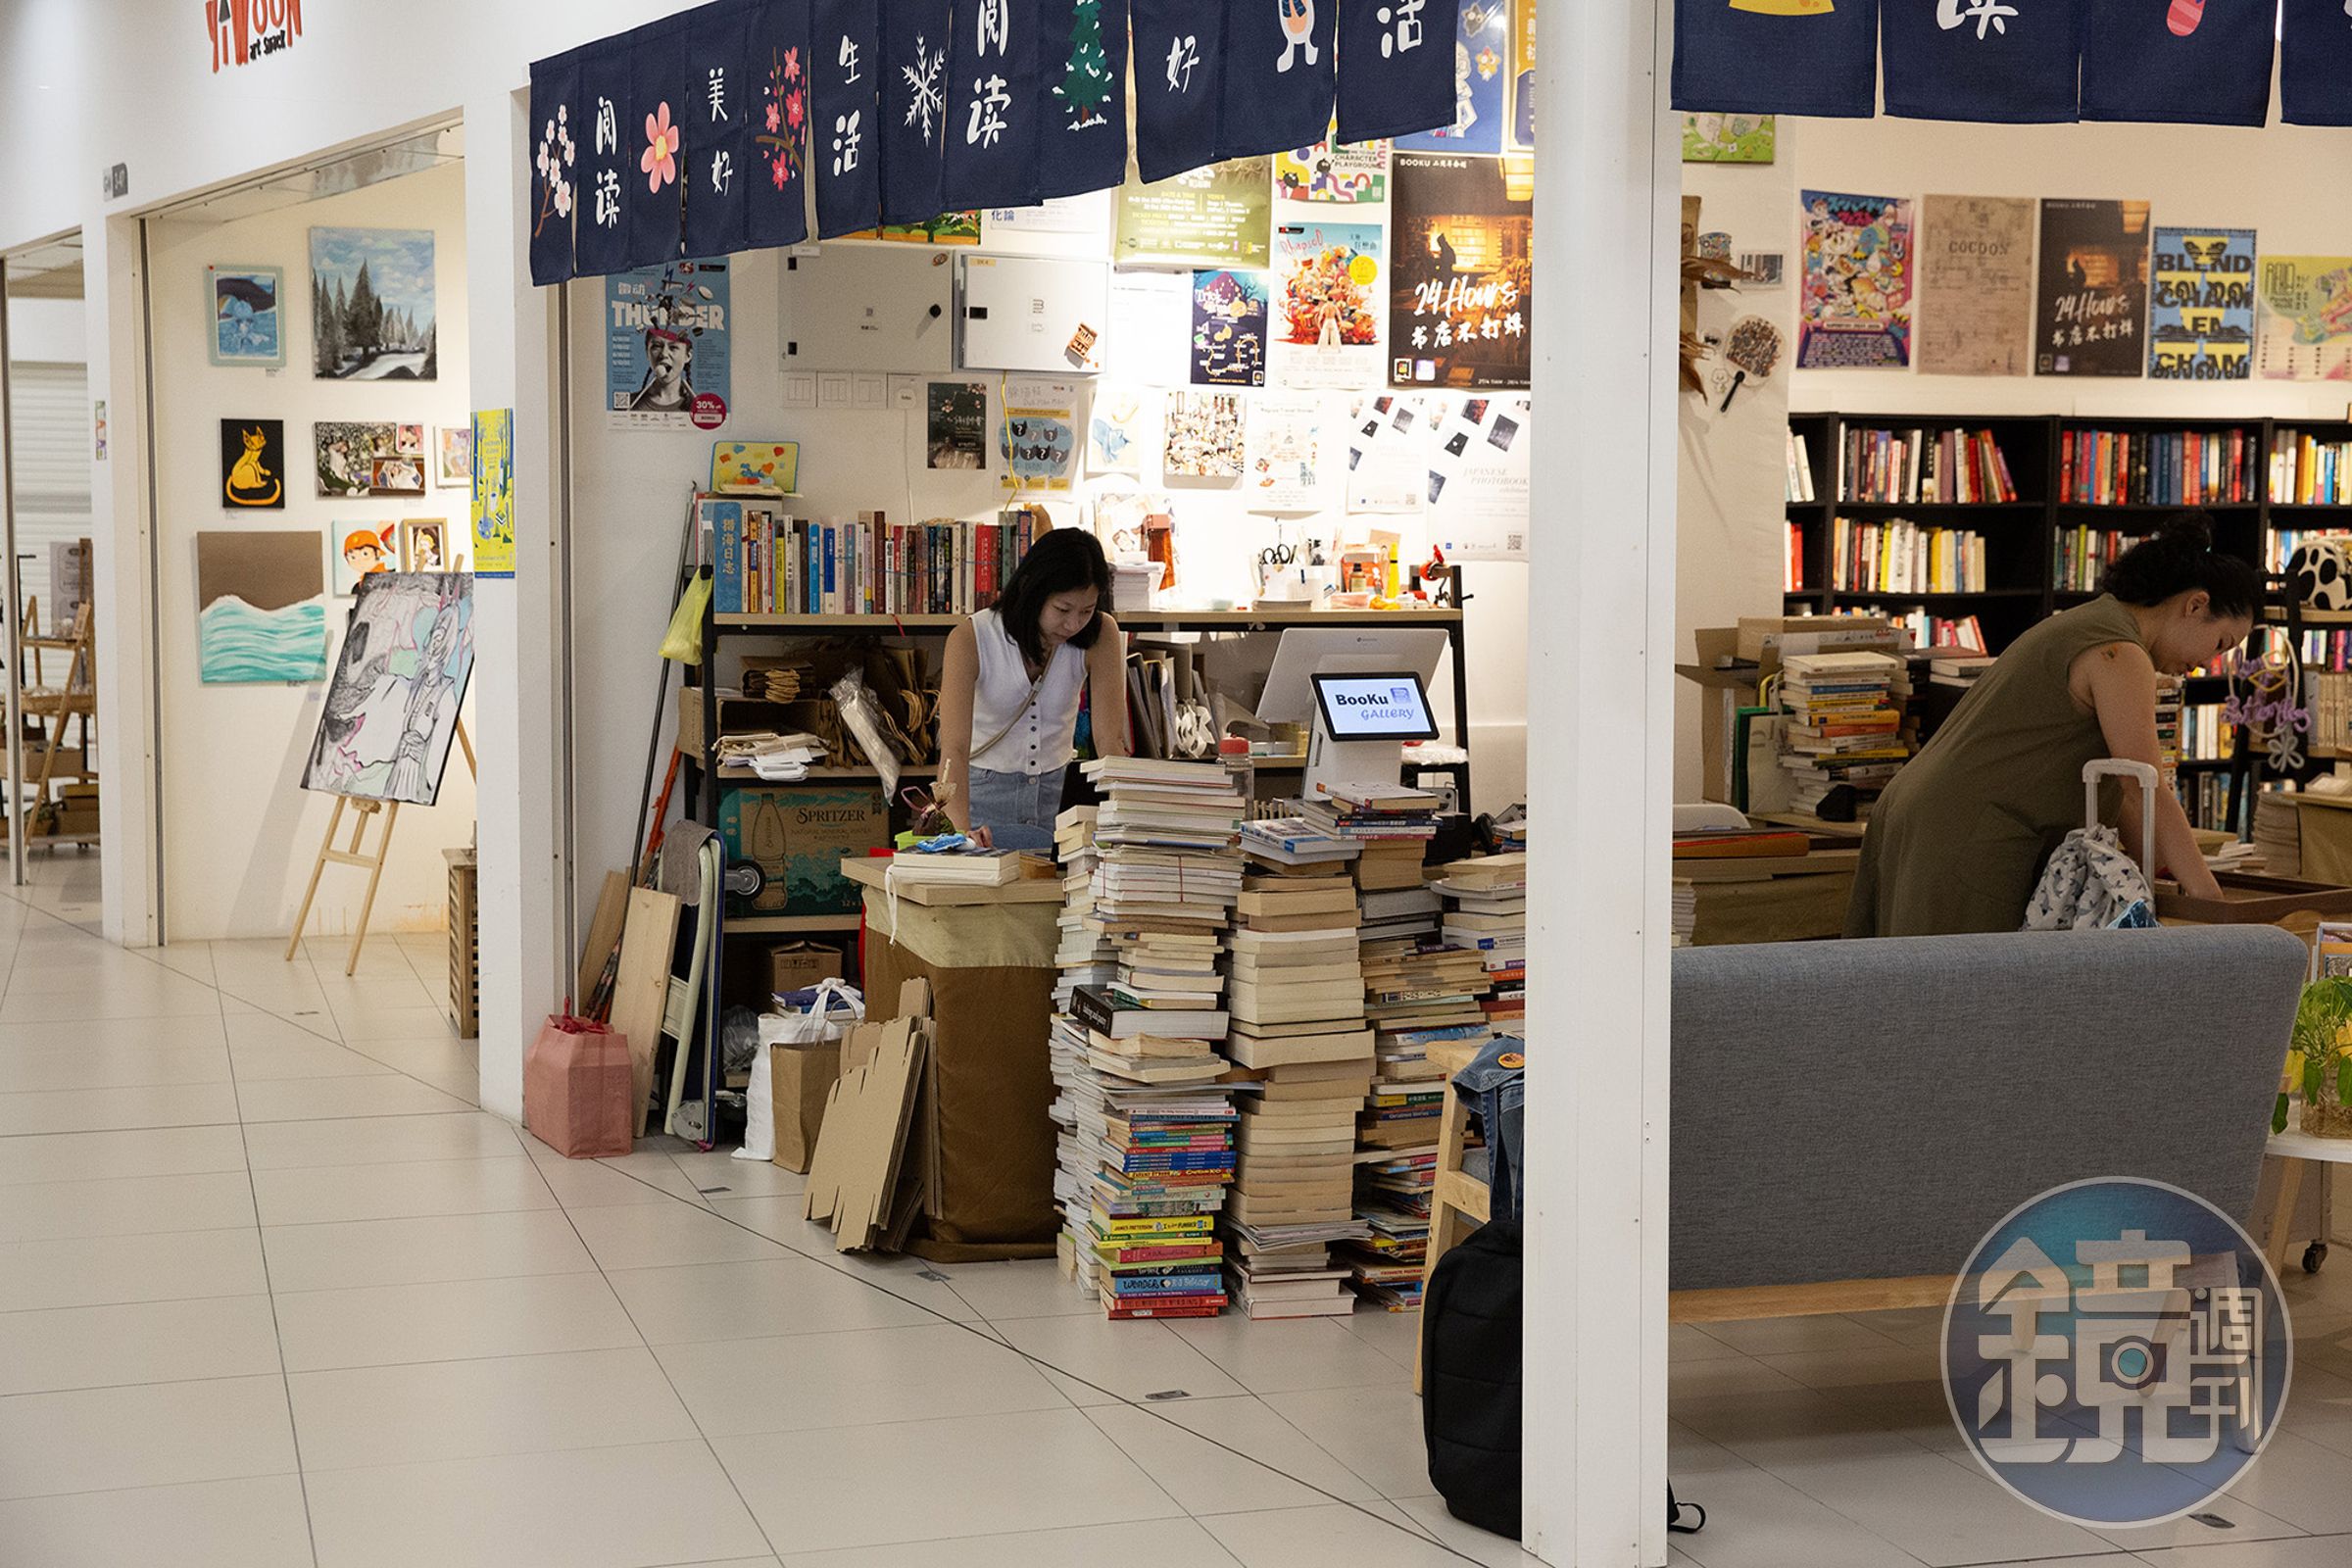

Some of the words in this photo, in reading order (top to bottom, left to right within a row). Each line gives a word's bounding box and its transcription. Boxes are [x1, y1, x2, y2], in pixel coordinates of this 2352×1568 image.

[1166, 35, 1200, 93] 好
[834, 34, 861, 176] 生活
[708, 67, 733, 196] 美好
[596, 96, 620, 229] 阅读
[1948, 240, 2009, 256] COCOON
[2156, 253, 2251, 271] BLEND
[1413, 277, 1444, 317] 24
[1440, 274, 1518, 318] Hours
[612, 300, 724, 330] THUNDER
[1411, 312, 1525, 350] 书店不打烊
[1335, 694, 1389, 706] BooKu
[797, 808, 865, 824] SPRITZER
[1123, 1280, 1159, 1290] WONDER
